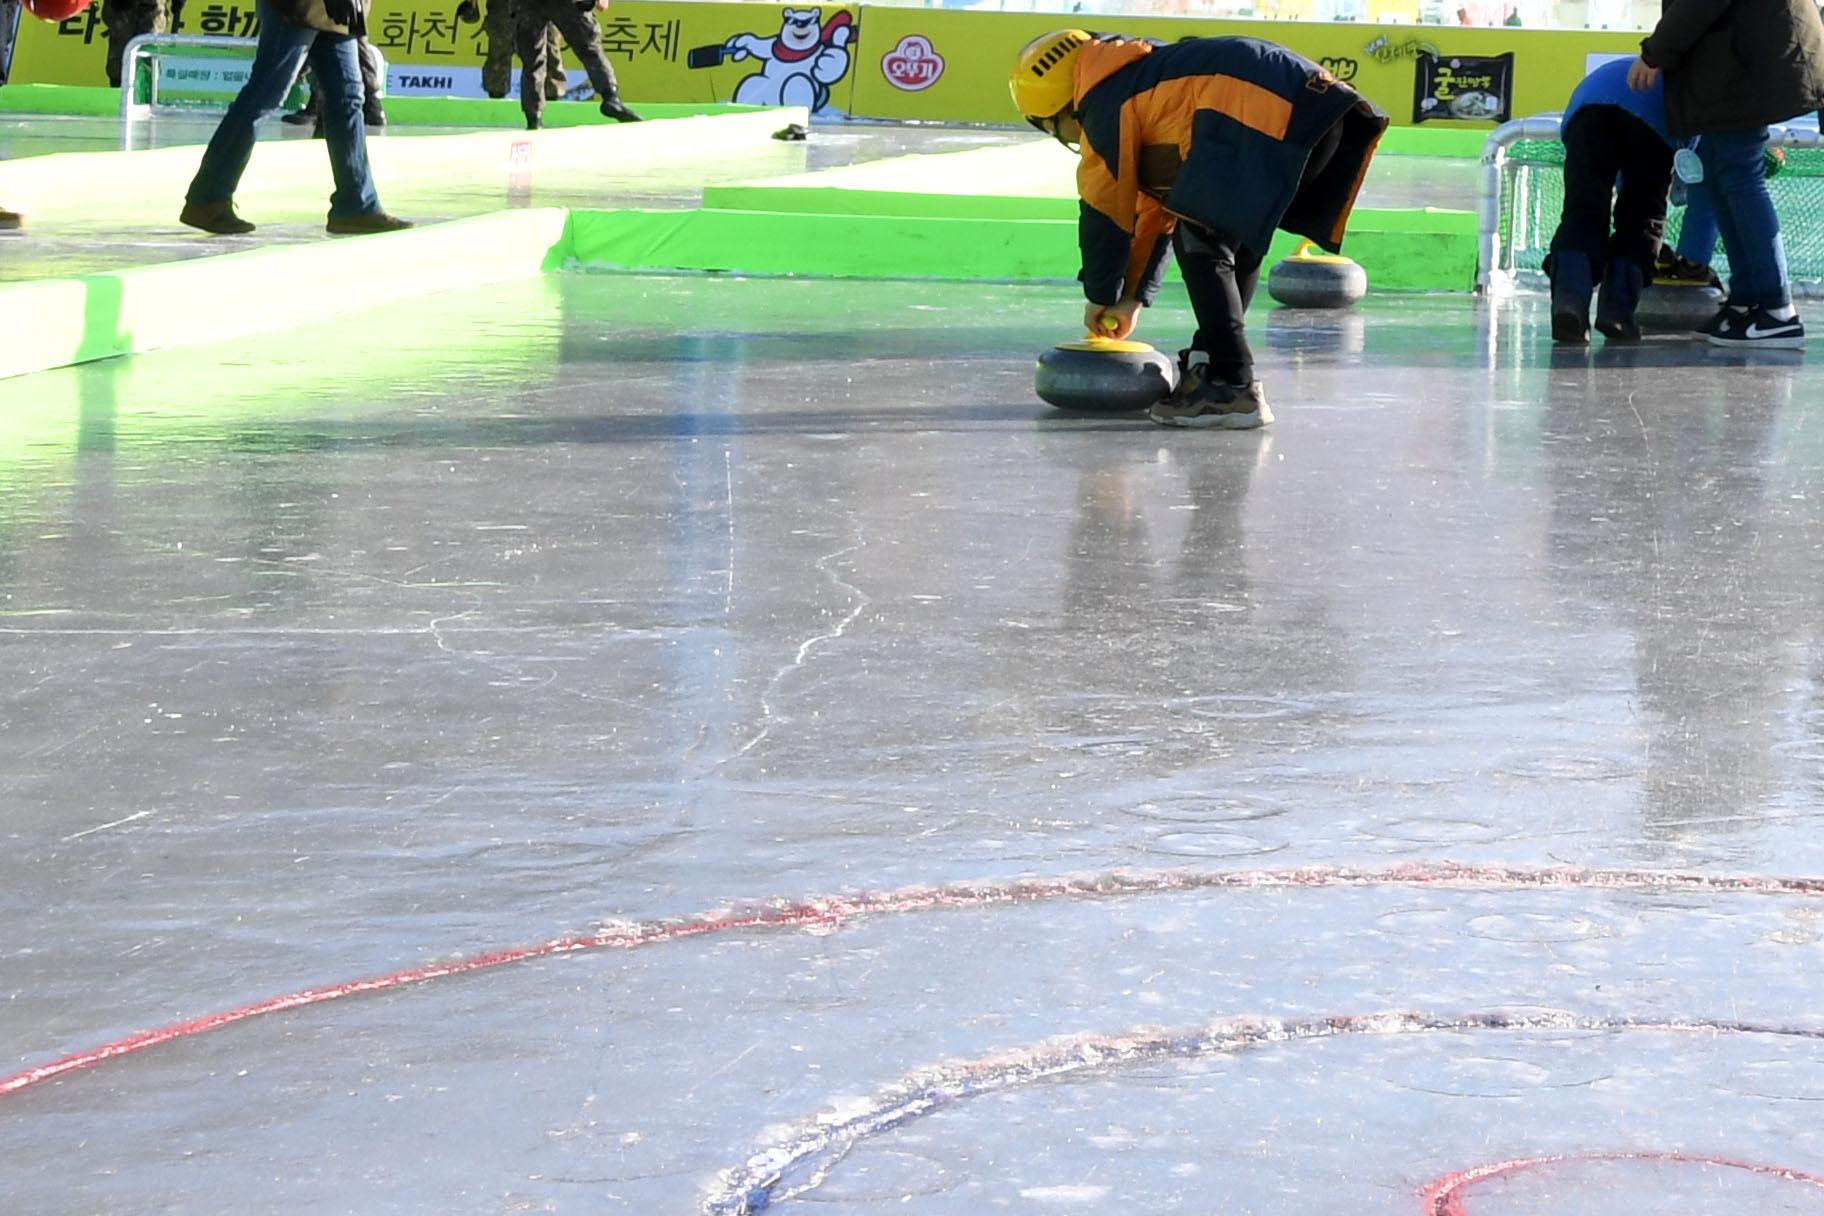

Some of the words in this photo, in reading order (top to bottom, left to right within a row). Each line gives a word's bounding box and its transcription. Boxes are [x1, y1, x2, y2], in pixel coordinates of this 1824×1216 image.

[377, 11, 458, 55] 화천
[602, 17, 681, 62] 축제
[891, 61, 934, 80] 오뚜기
[399, 75, 452, 89] TAKHI
